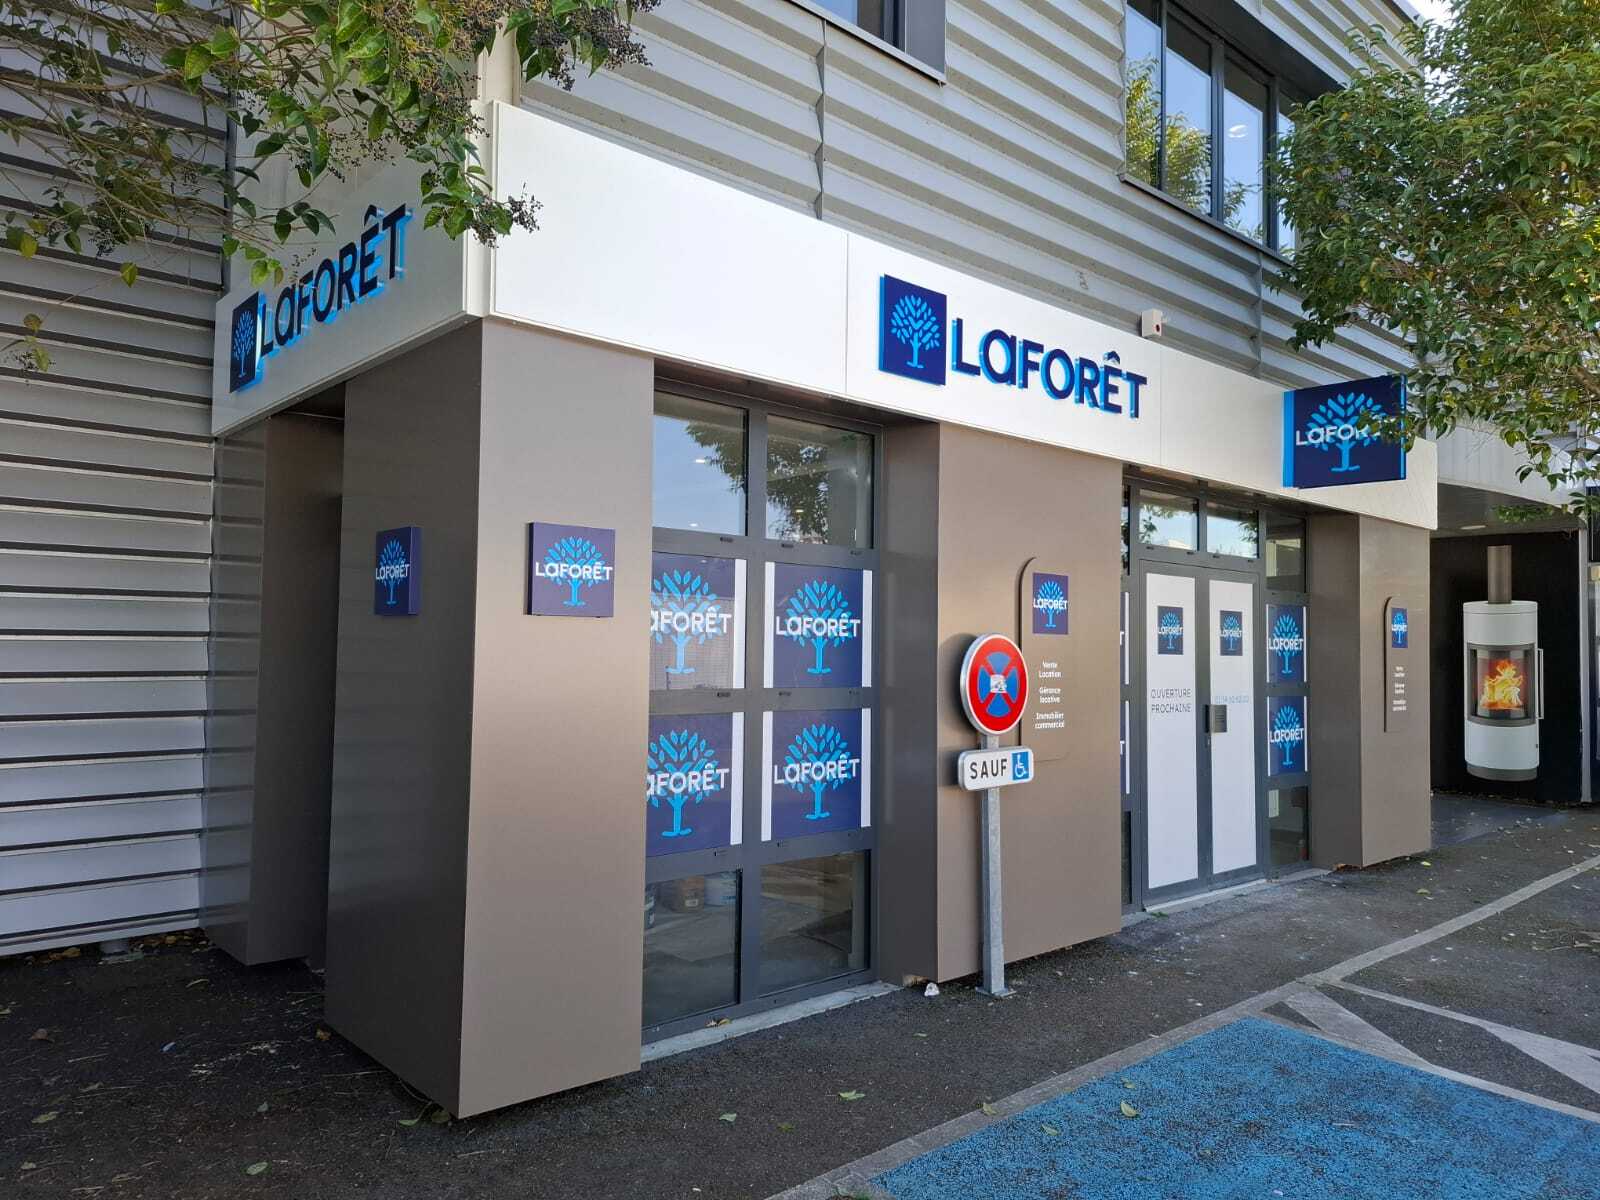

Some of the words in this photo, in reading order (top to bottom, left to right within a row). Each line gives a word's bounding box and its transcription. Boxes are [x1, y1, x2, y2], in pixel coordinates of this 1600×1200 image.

[1150, 688, 1192, 699] OUVERTURE
[1151, 702, 1192, 714] PROCHAINE
[969, 758, 1008, 780] SAUF
